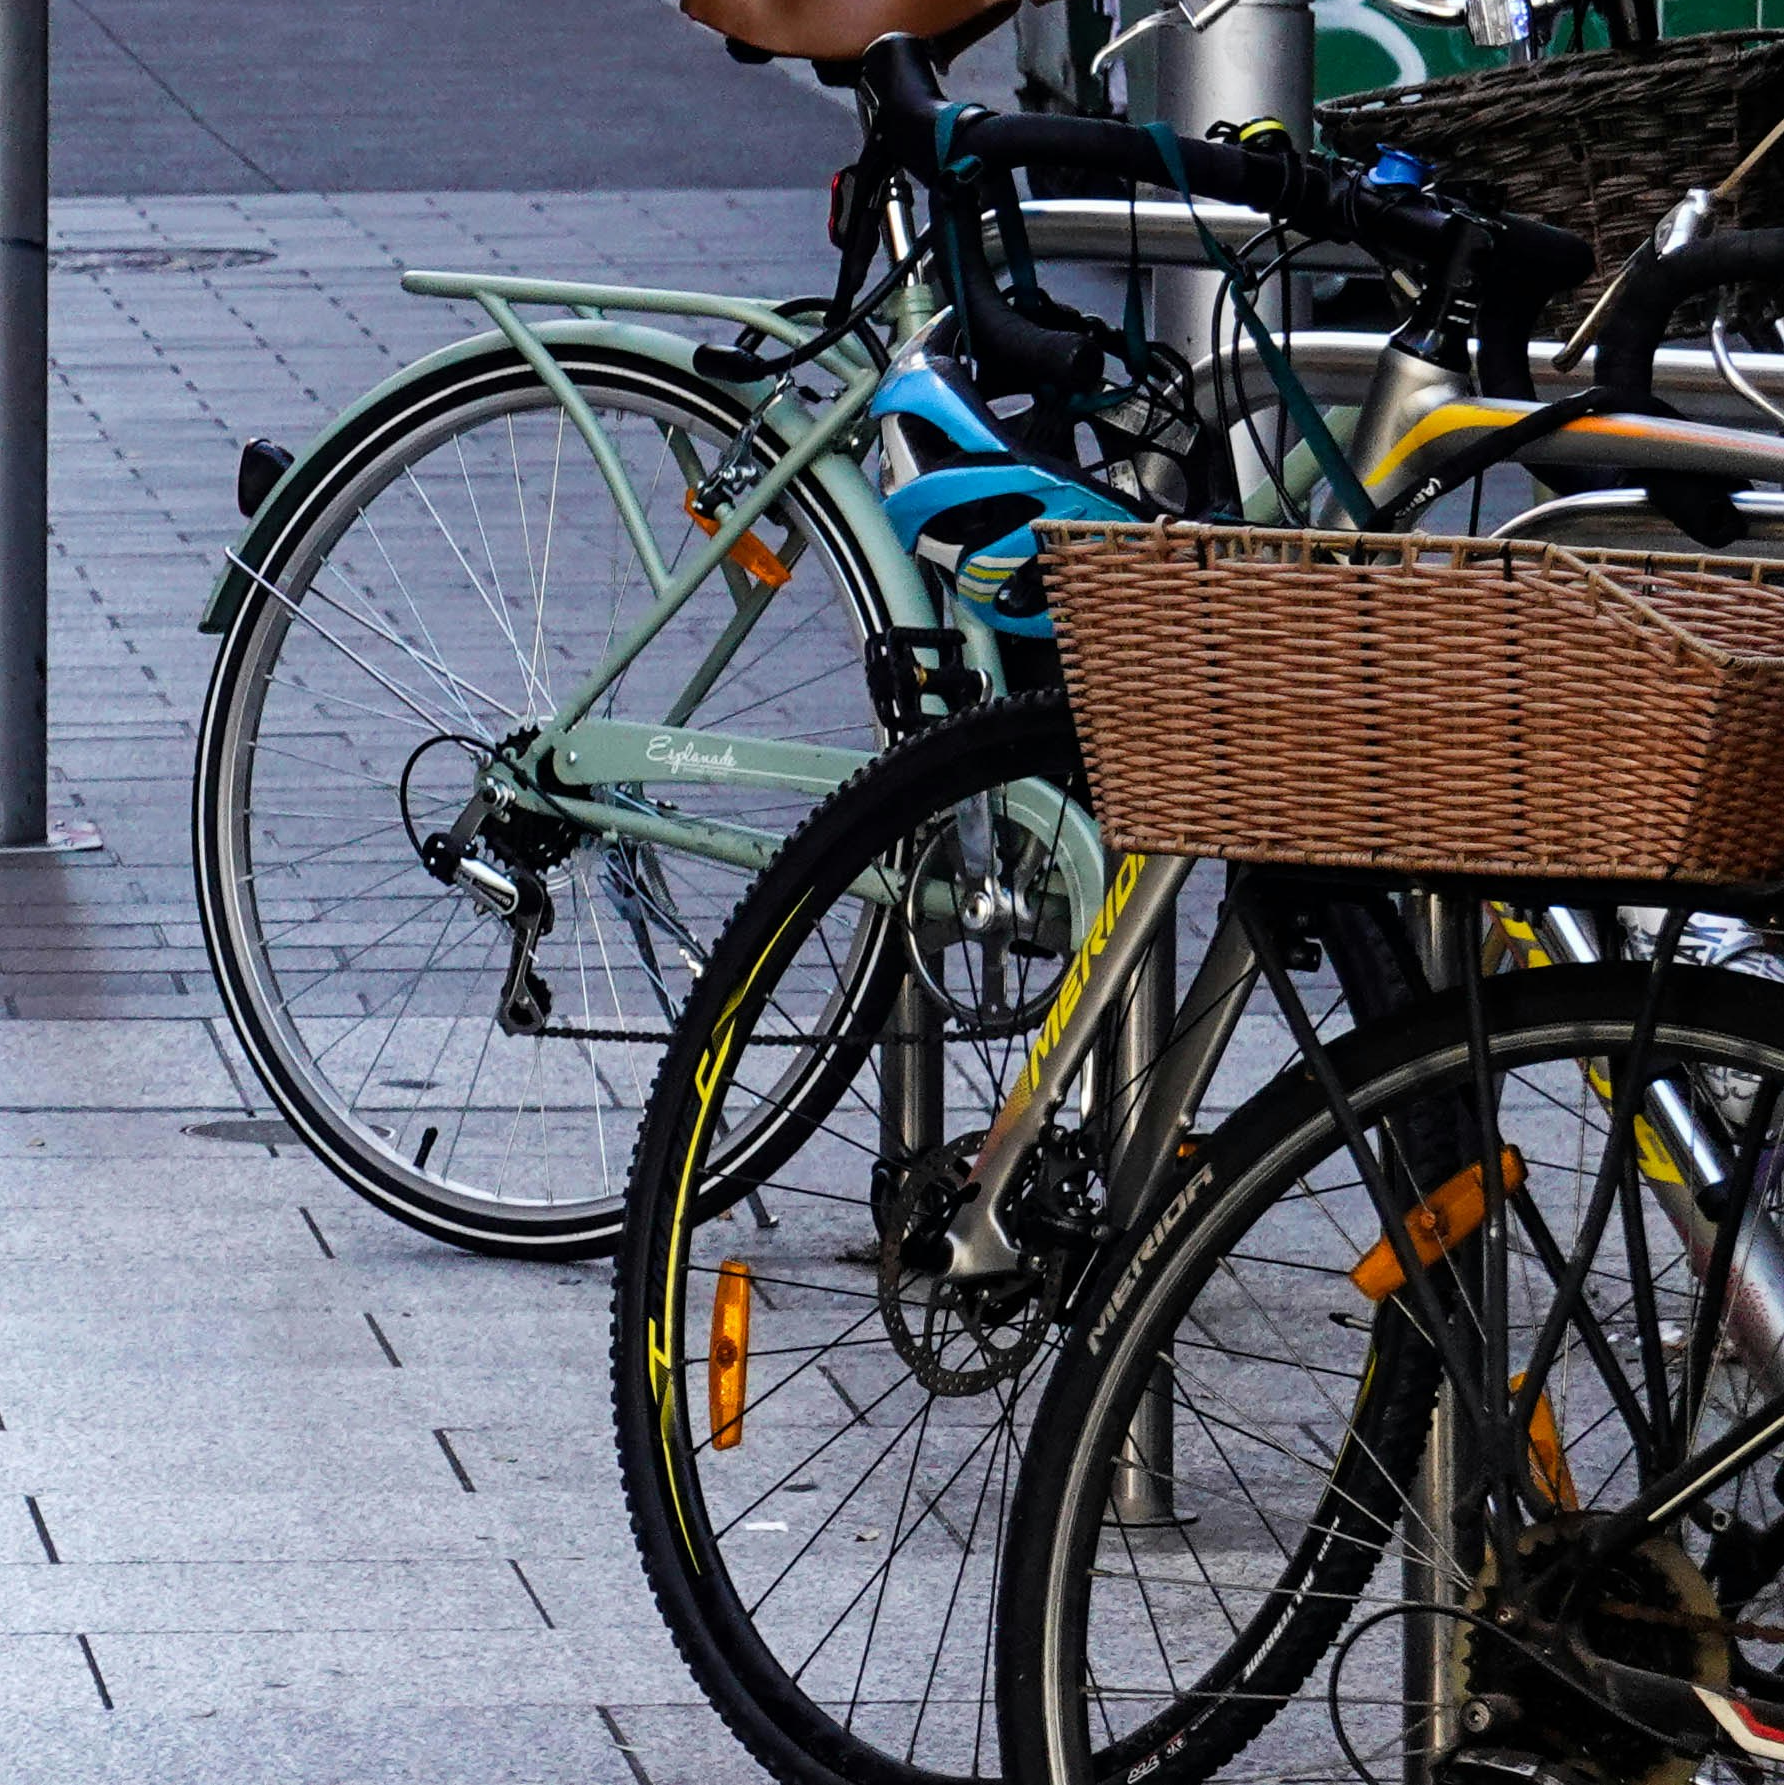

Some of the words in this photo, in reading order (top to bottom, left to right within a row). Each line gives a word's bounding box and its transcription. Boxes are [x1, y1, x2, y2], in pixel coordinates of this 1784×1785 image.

[646, 735, 737, 774] Esplanade
[1029, 855, 1147, 1093] MERID
[1086, 1162, 1216, 1355] MERIDA
